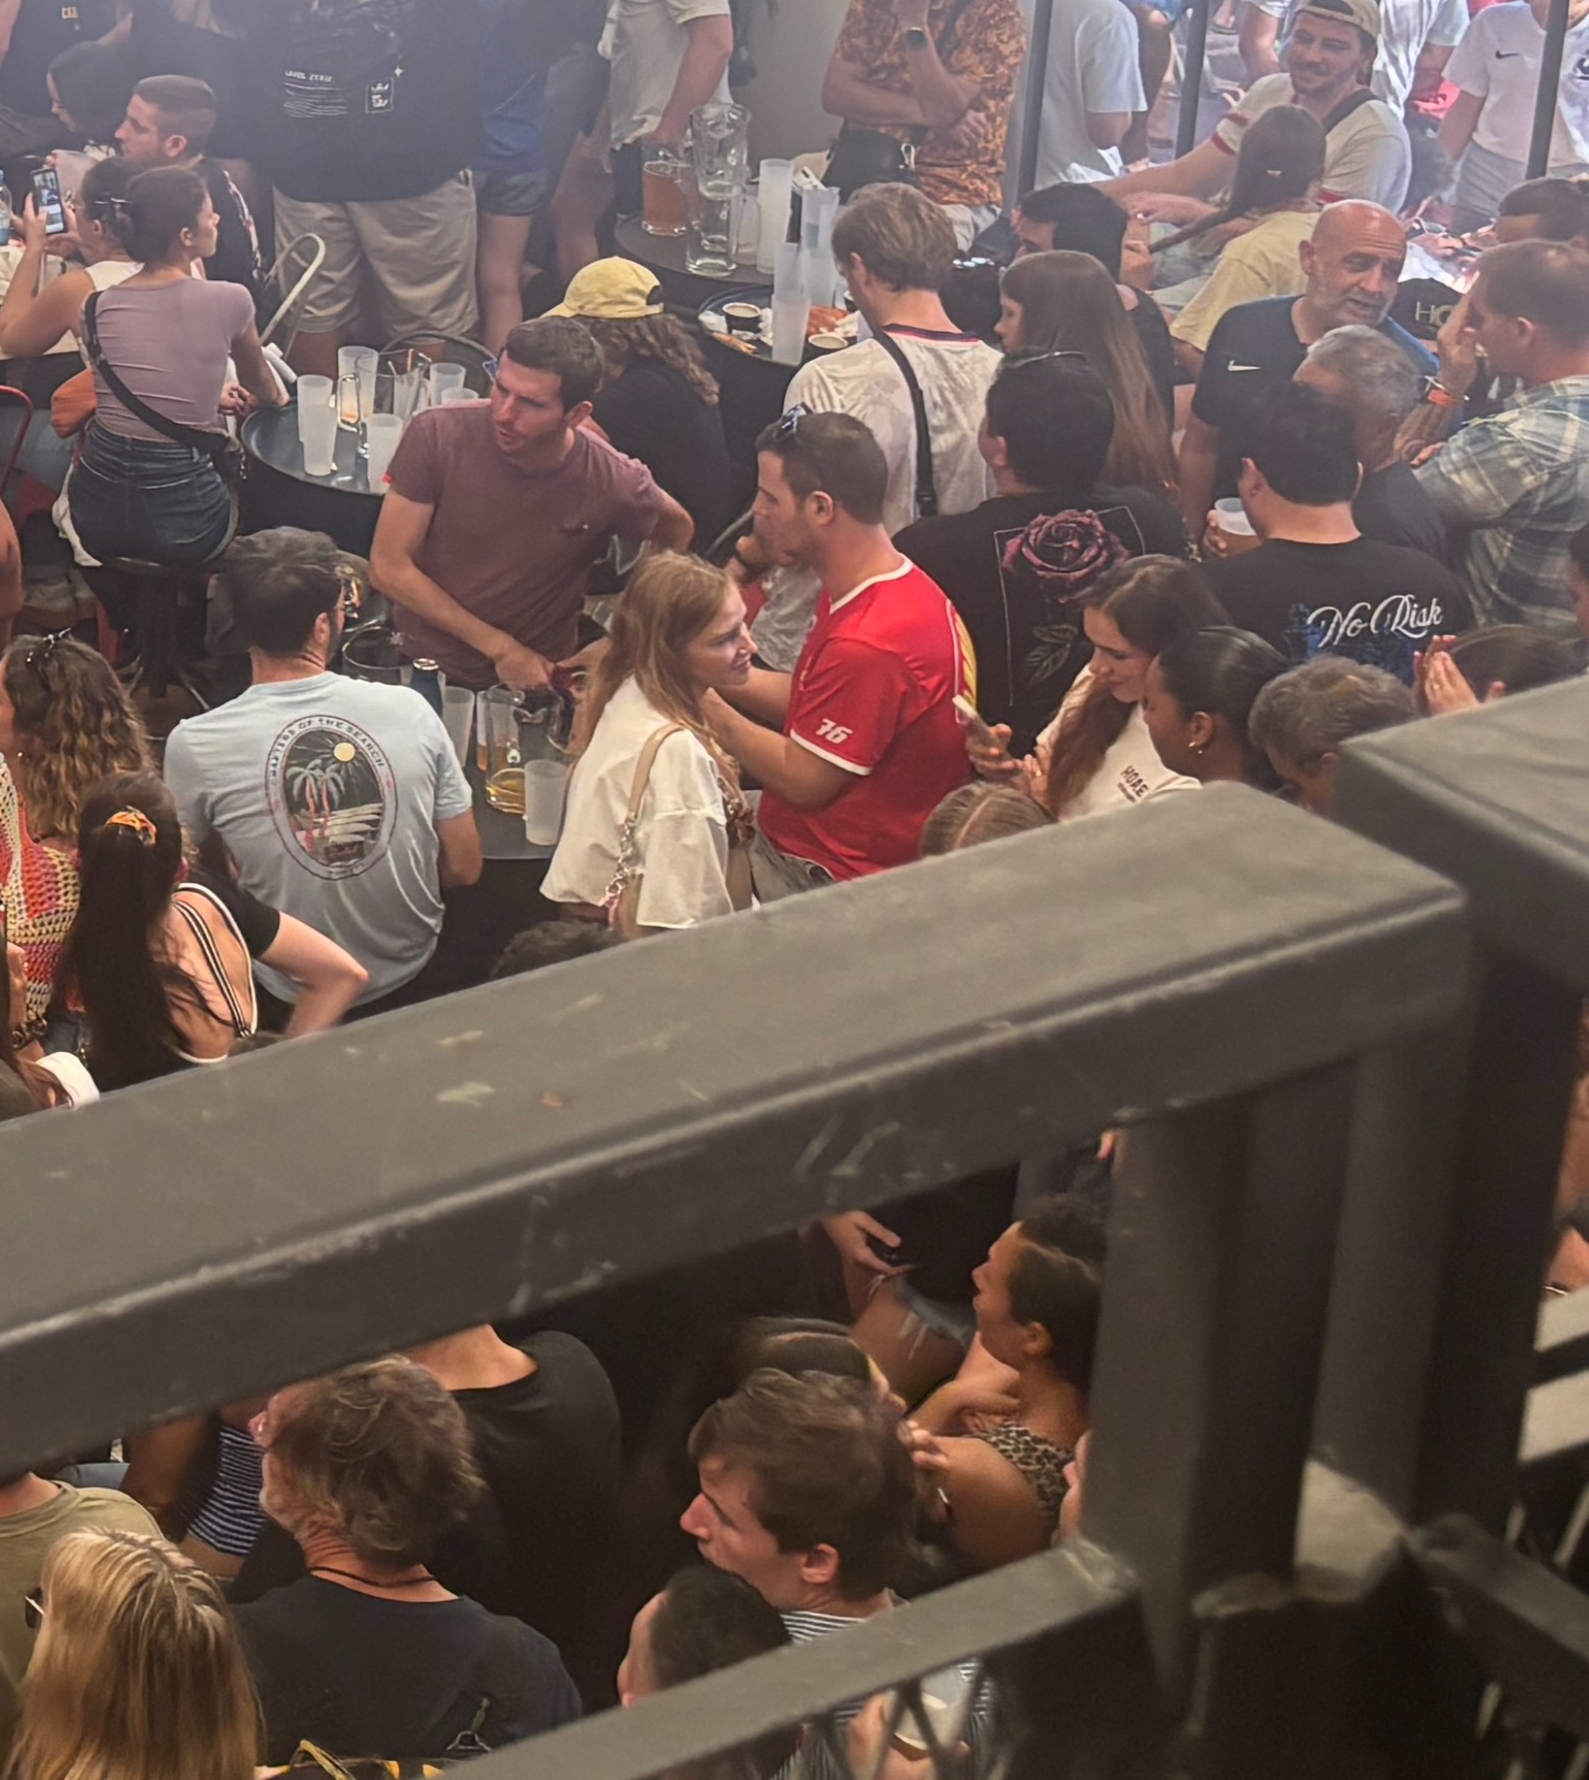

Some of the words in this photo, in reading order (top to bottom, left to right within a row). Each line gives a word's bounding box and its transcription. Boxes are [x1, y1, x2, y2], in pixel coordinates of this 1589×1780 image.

[1306, 598, 1371, 648] No
[1370, 593, 1443, 639] Risk
[815, 718, 853, 744] 76
